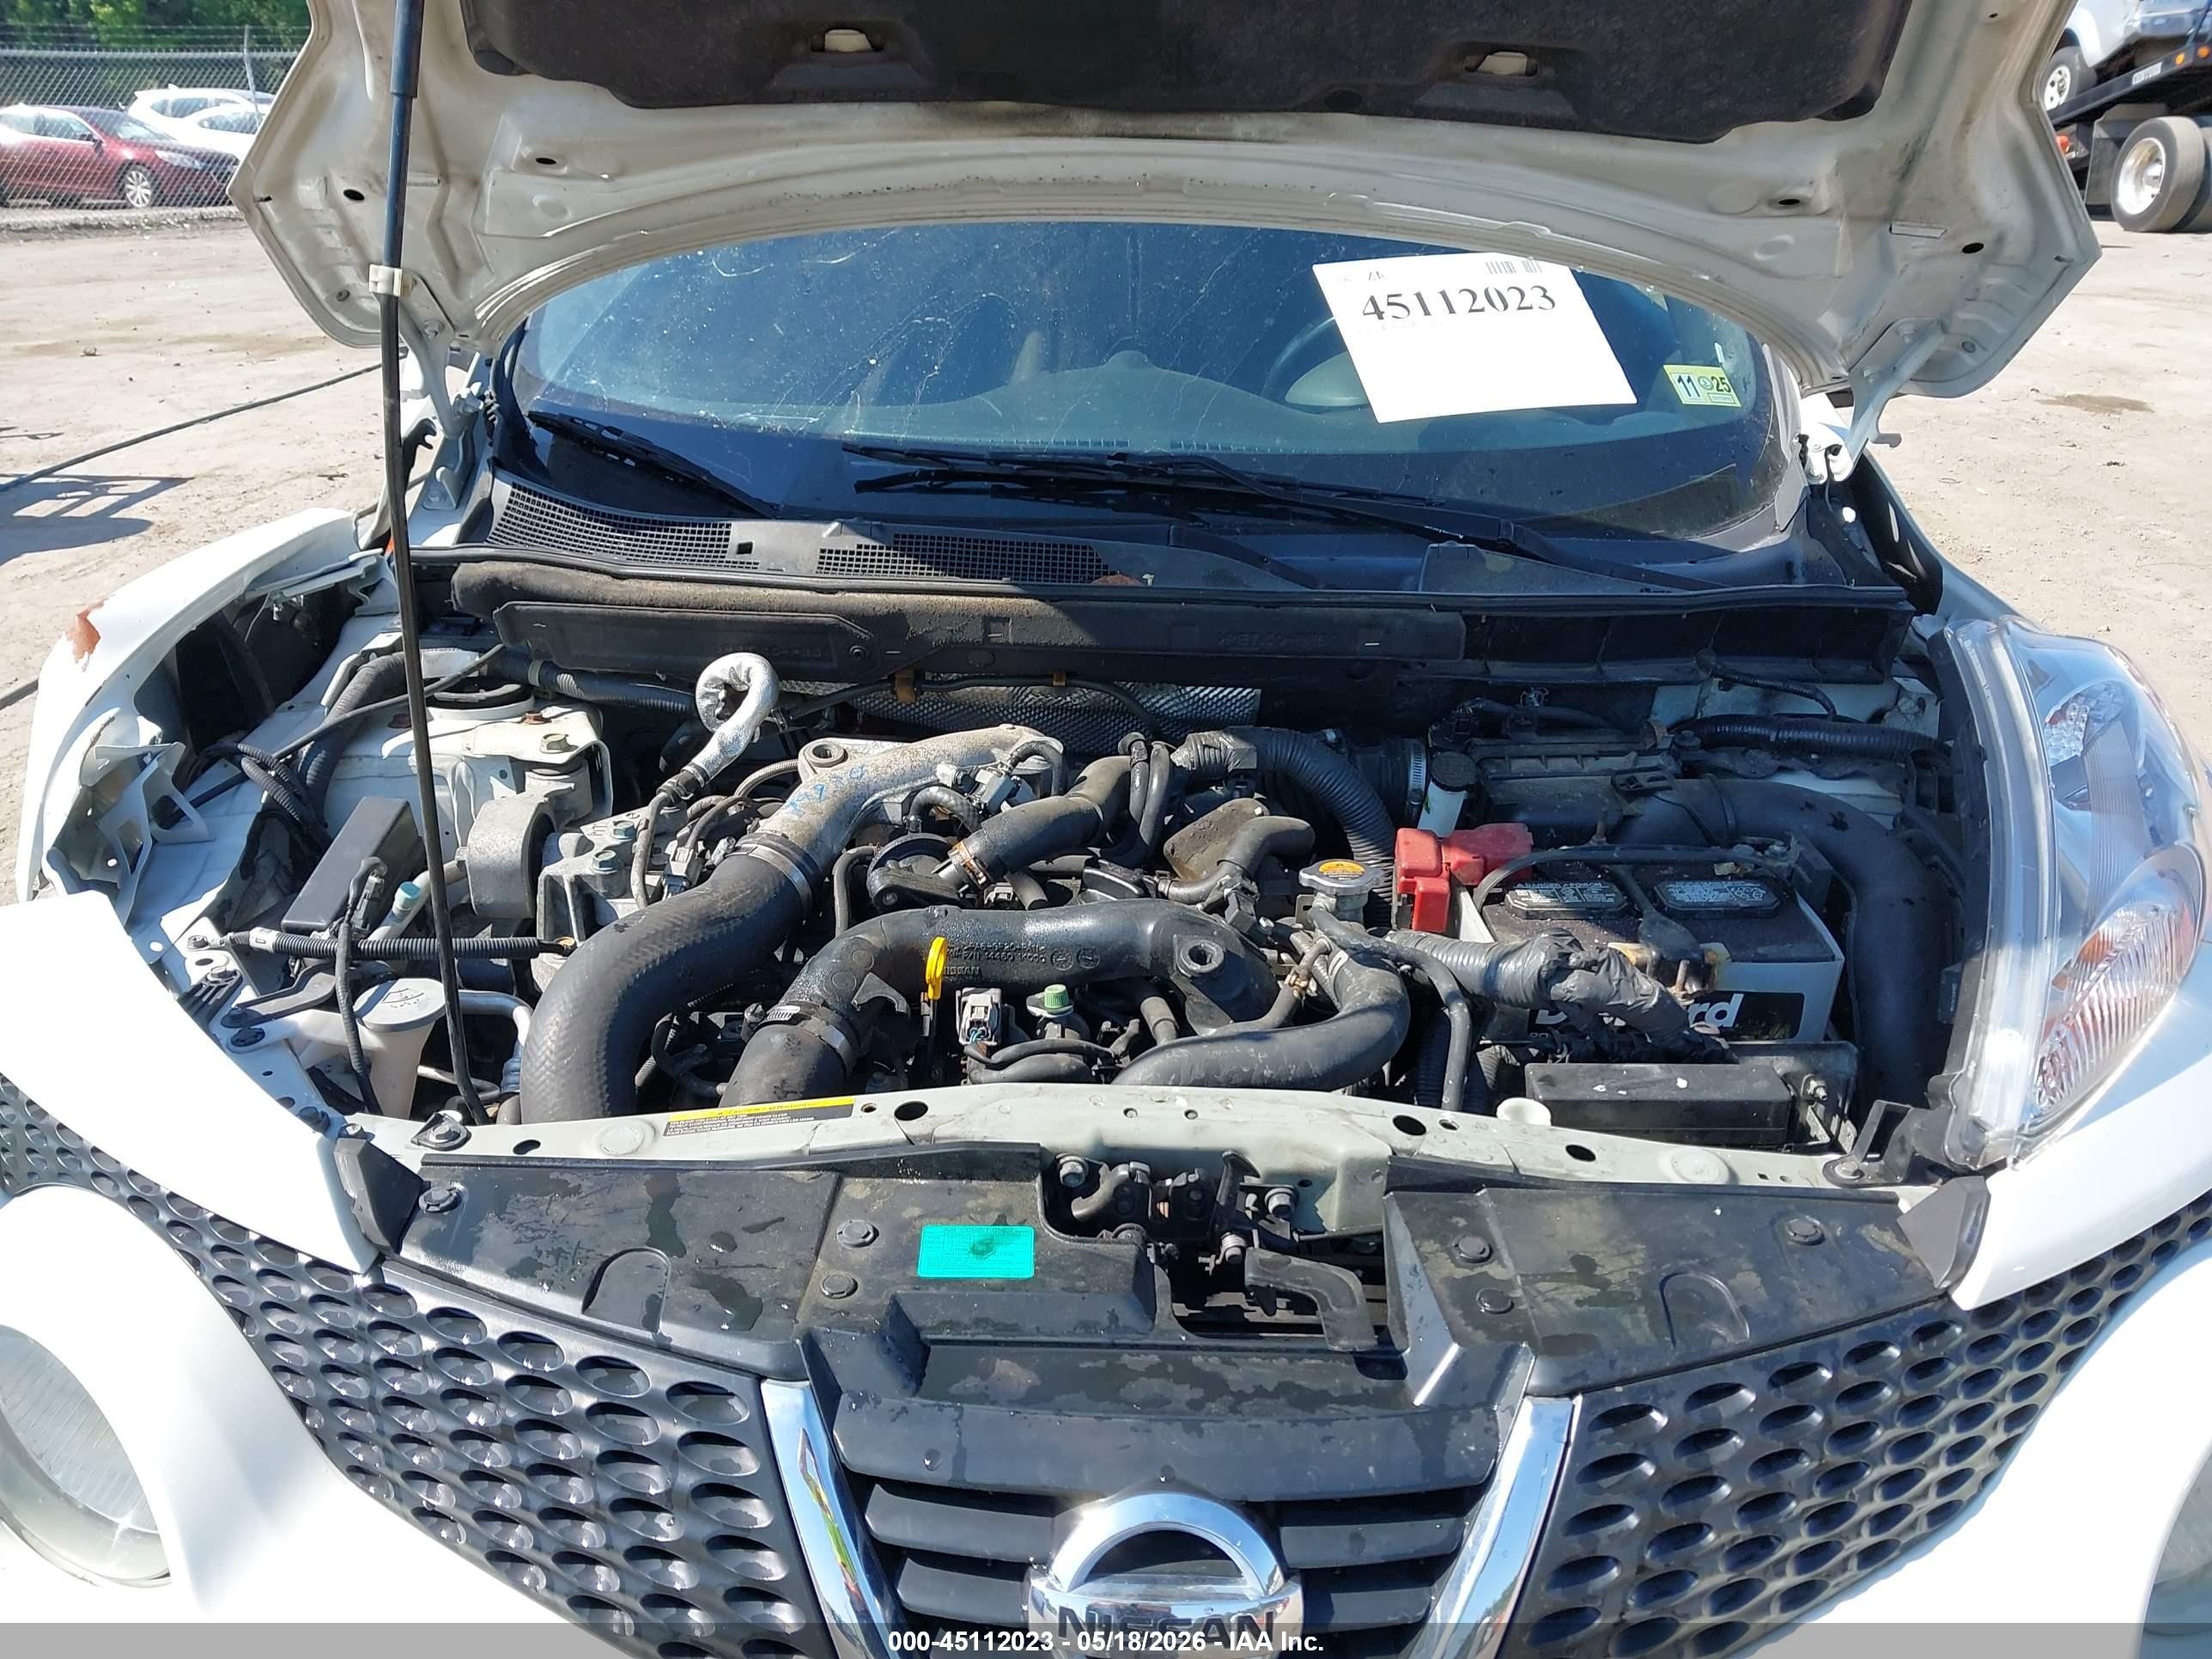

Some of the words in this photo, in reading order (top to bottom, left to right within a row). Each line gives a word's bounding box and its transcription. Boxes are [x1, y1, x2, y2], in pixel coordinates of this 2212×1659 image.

[1363, 285, 1555, 320] 45112023
[1677, 375, 1700, 398] 11
[1710, 375, 1732, 393] 25
[1057, 1606, 1276, 1651] NISSAN
